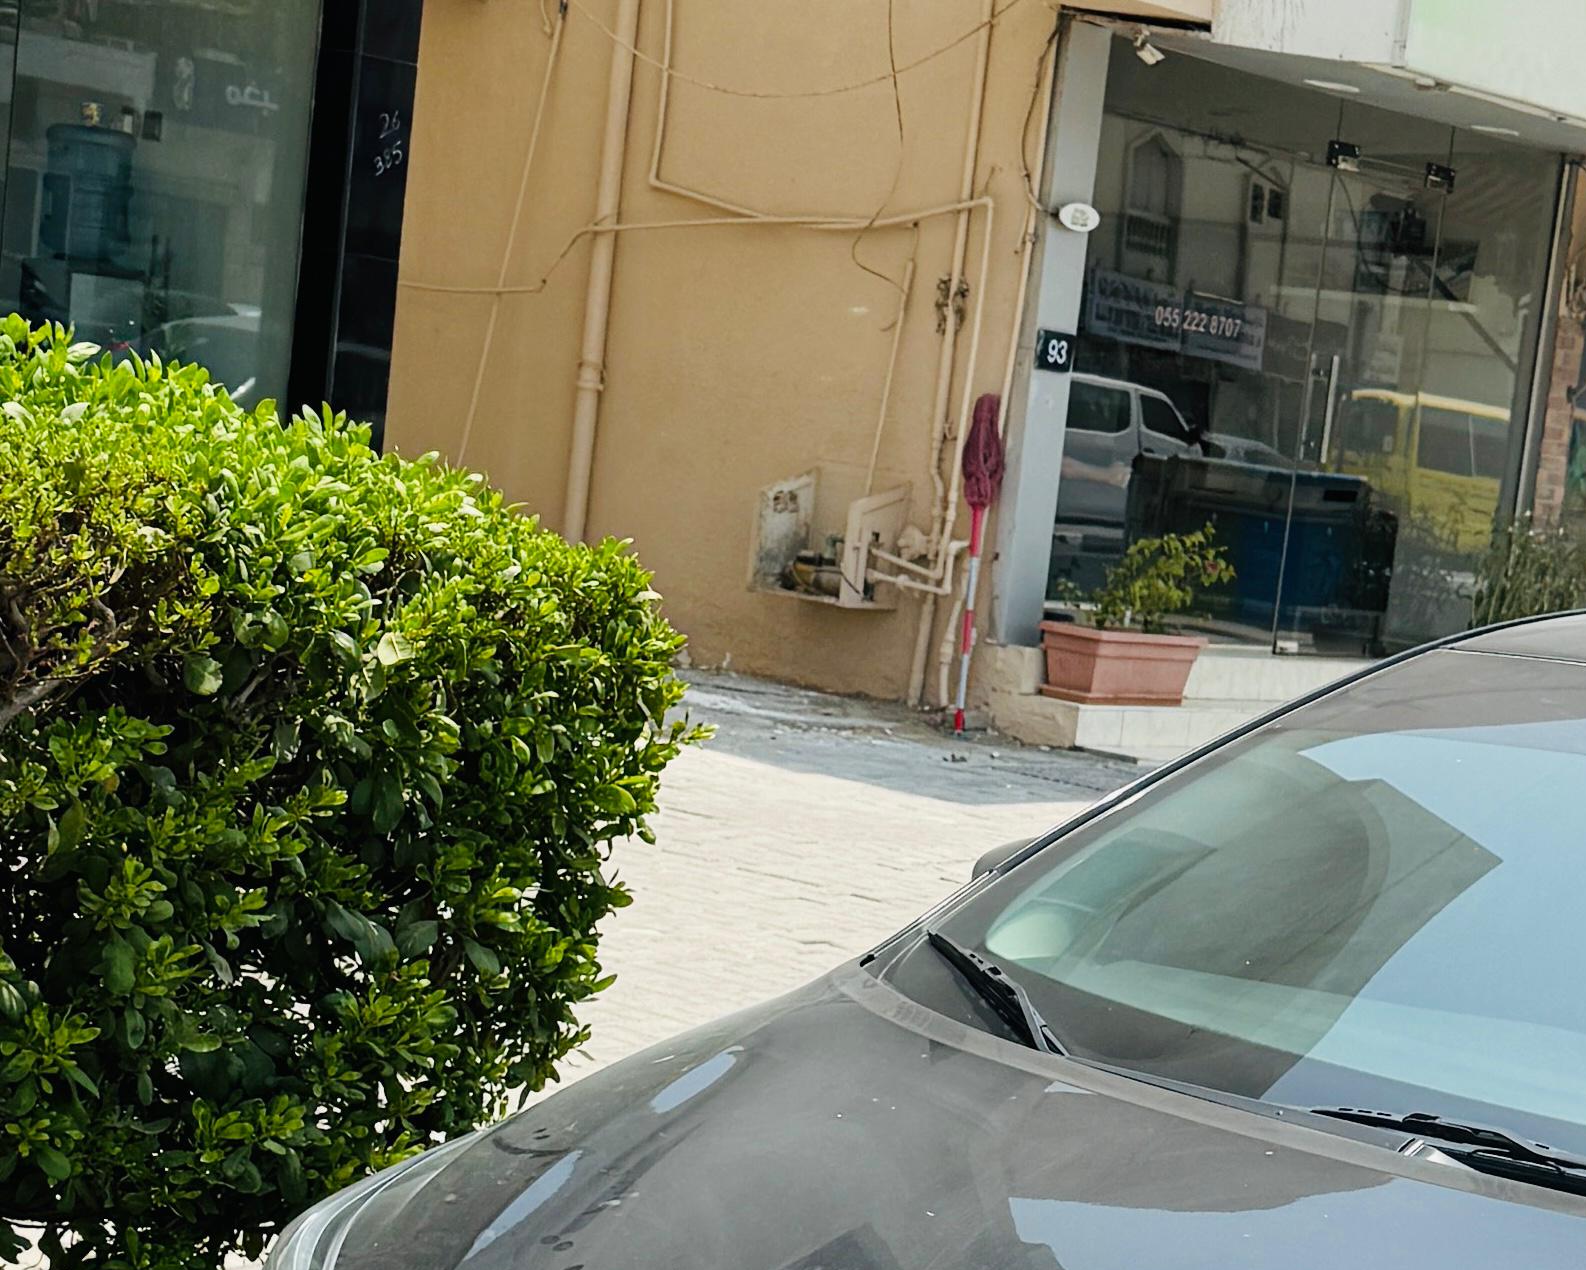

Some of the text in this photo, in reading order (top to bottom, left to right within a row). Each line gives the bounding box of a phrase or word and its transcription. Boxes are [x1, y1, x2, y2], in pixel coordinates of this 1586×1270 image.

[1155, 306, 1241, 338] 055 222 8707
[1047, 339, 1068, 364] 93
